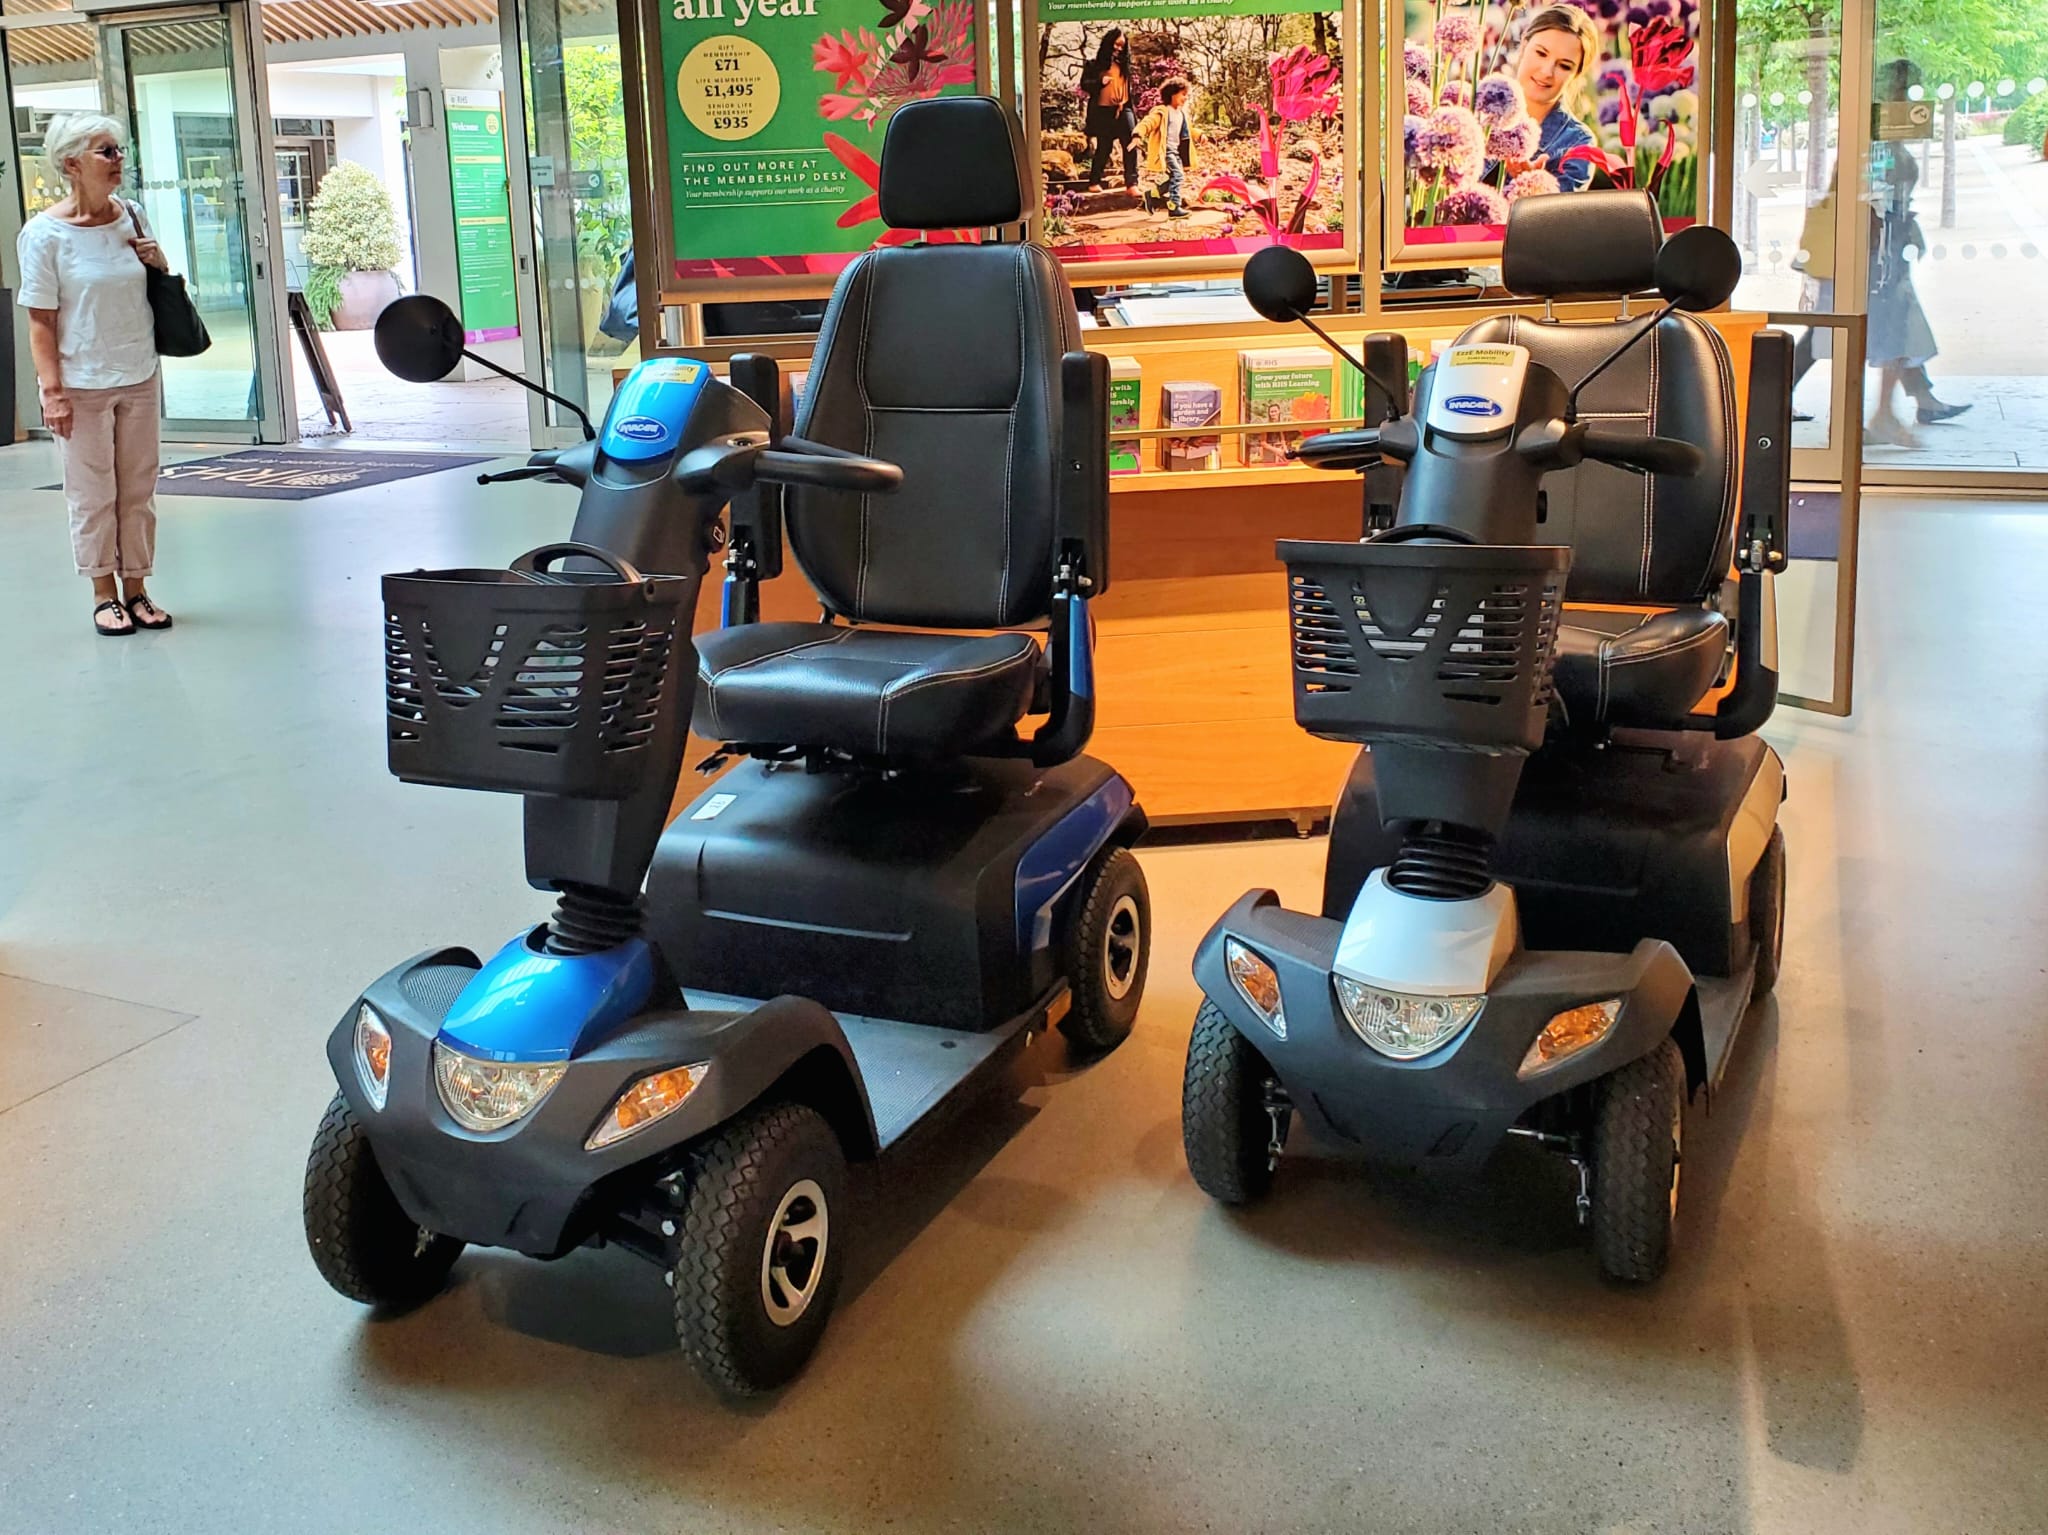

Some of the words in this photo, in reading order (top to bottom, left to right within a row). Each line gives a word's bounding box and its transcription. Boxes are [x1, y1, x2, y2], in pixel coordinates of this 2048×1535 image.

[1048, 2, 1066, 10] Your
[1067, 0, 1116, 9] membership
[1117, 0, 1151, 8] supports
[734, 0, 819, 27] year
[715, 58, 741, 71] £71
[704, 83, 754, 99] £1,495
[714, 116, 749, 129] £935
[683, 163, 716, 173] FIND
[722, 162, 750, 172] OUT
[757, 160, 795, 171] MORE
[802, 160, 817, 169] AT
[683, 176, 711, 186] THE
[717, 173, 806, 185] MEMBERSHIP
[813, 171, 847, 181] DESK
[686, 189, 702, 198] Your
[702, 188, 744, 198] membership
[744, 187, 773, 197] supports
[787, 186, 805, 194] work
[820, 184, 846, 194] charity
[1273, 374, 1290, 382] your
[1291, 372, 1313, 380] future
[1255, 381, 1271, 389] with
[1288, 379, 1320, 388] Learning
